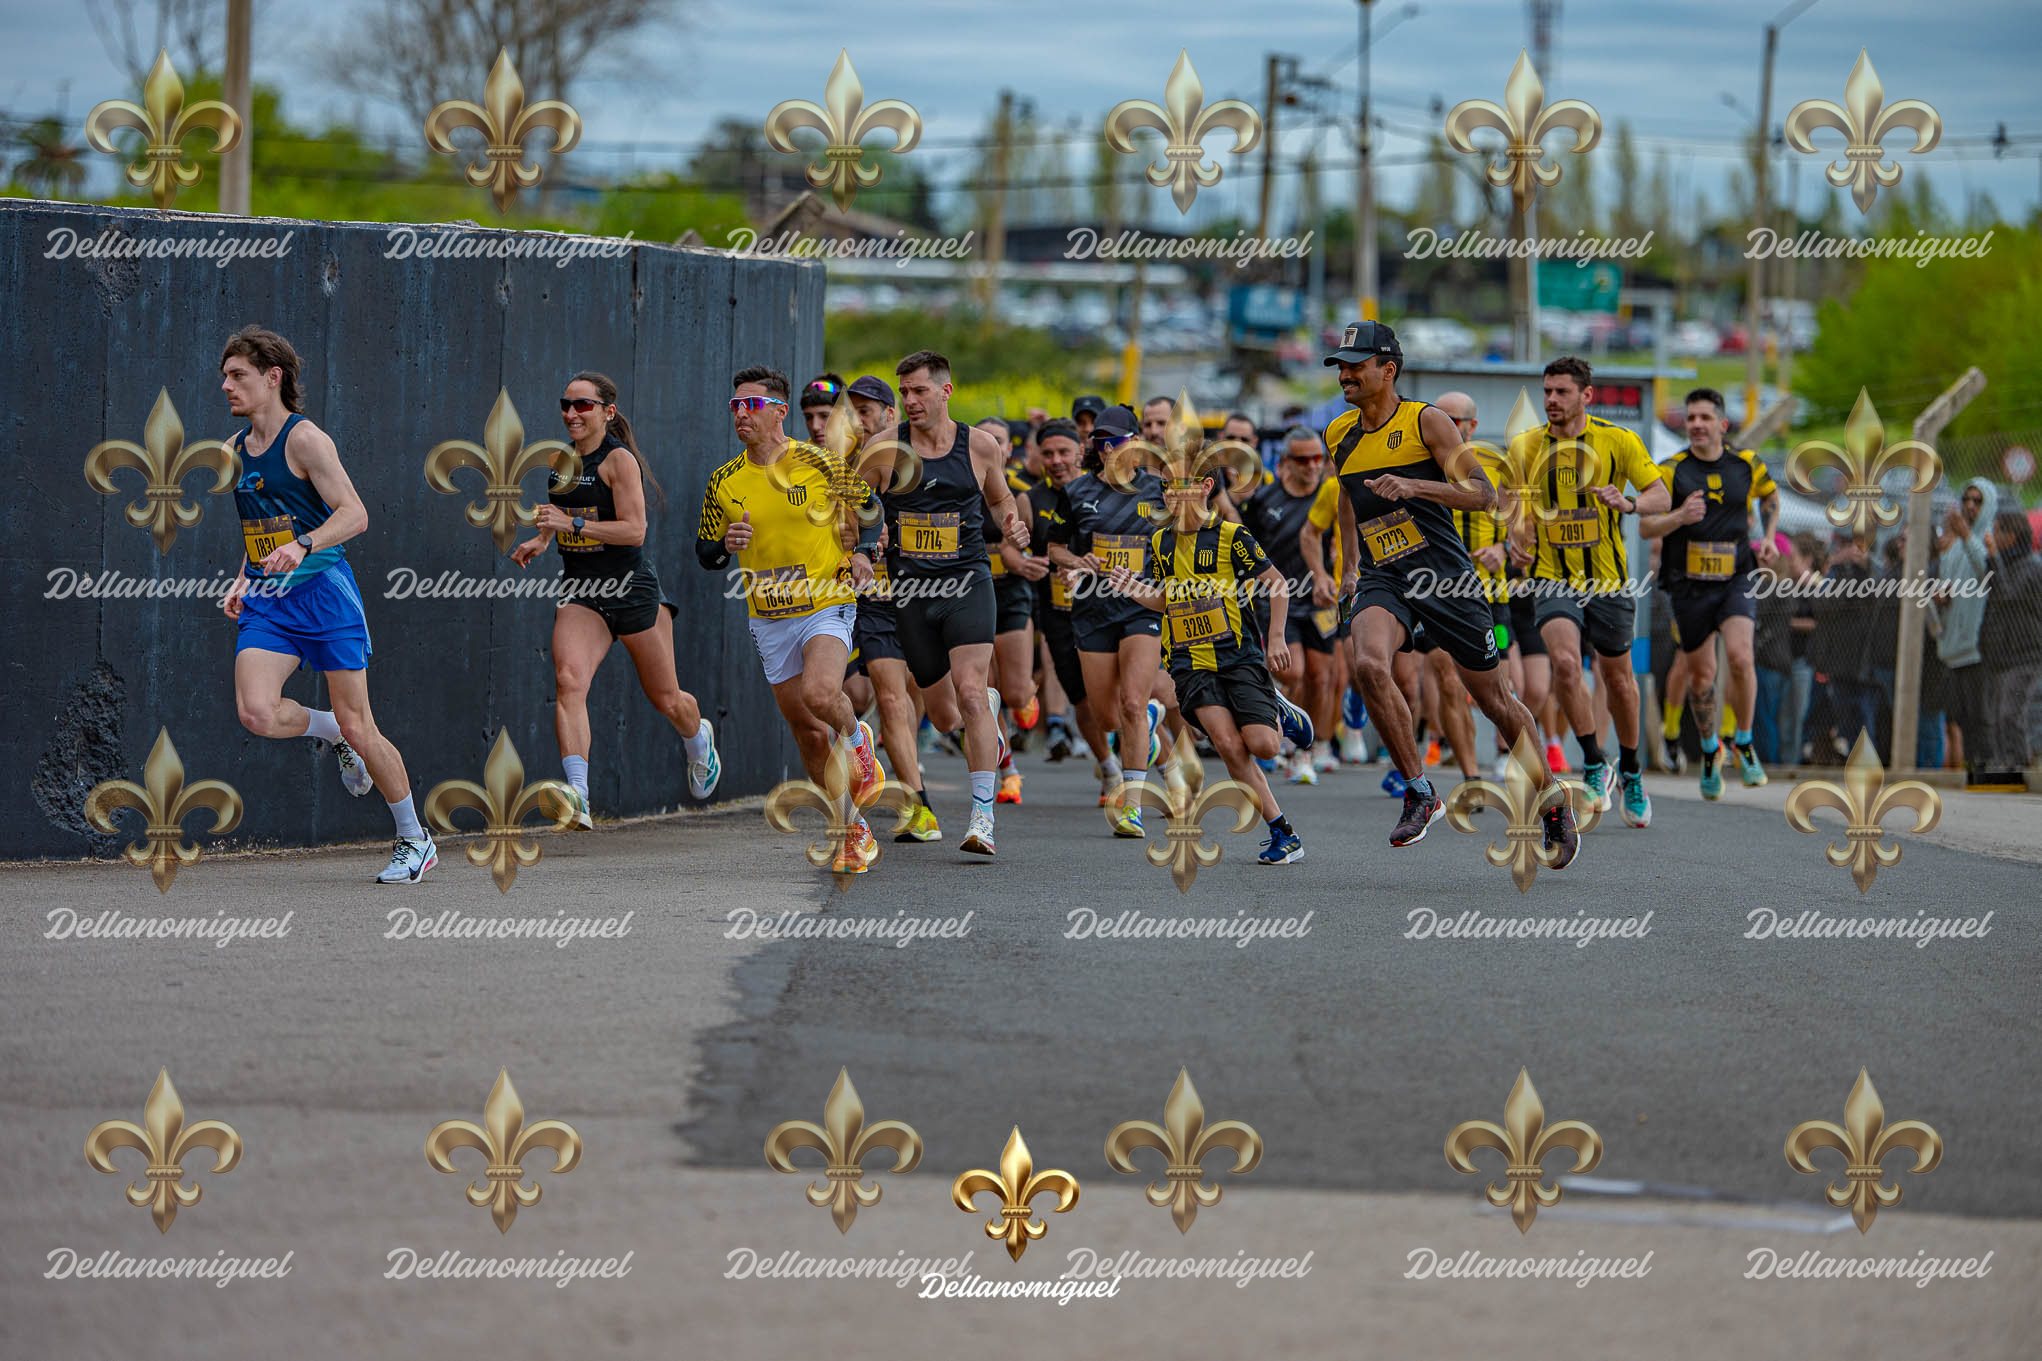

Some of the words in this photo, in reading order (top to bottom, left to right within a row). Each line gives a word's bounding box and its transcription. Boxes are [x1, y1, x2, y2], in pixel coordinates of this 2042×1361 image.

[916, 529, 942, 550] 0714
[1376, 528, 1409, 555] 2773
[1560, 523, 1585, 541] 2091
[1105, 551, 1130, 569] 2123
[1233, 541, 1255, 570] BBVA
[1183, 615, 1213, 639] 3288
